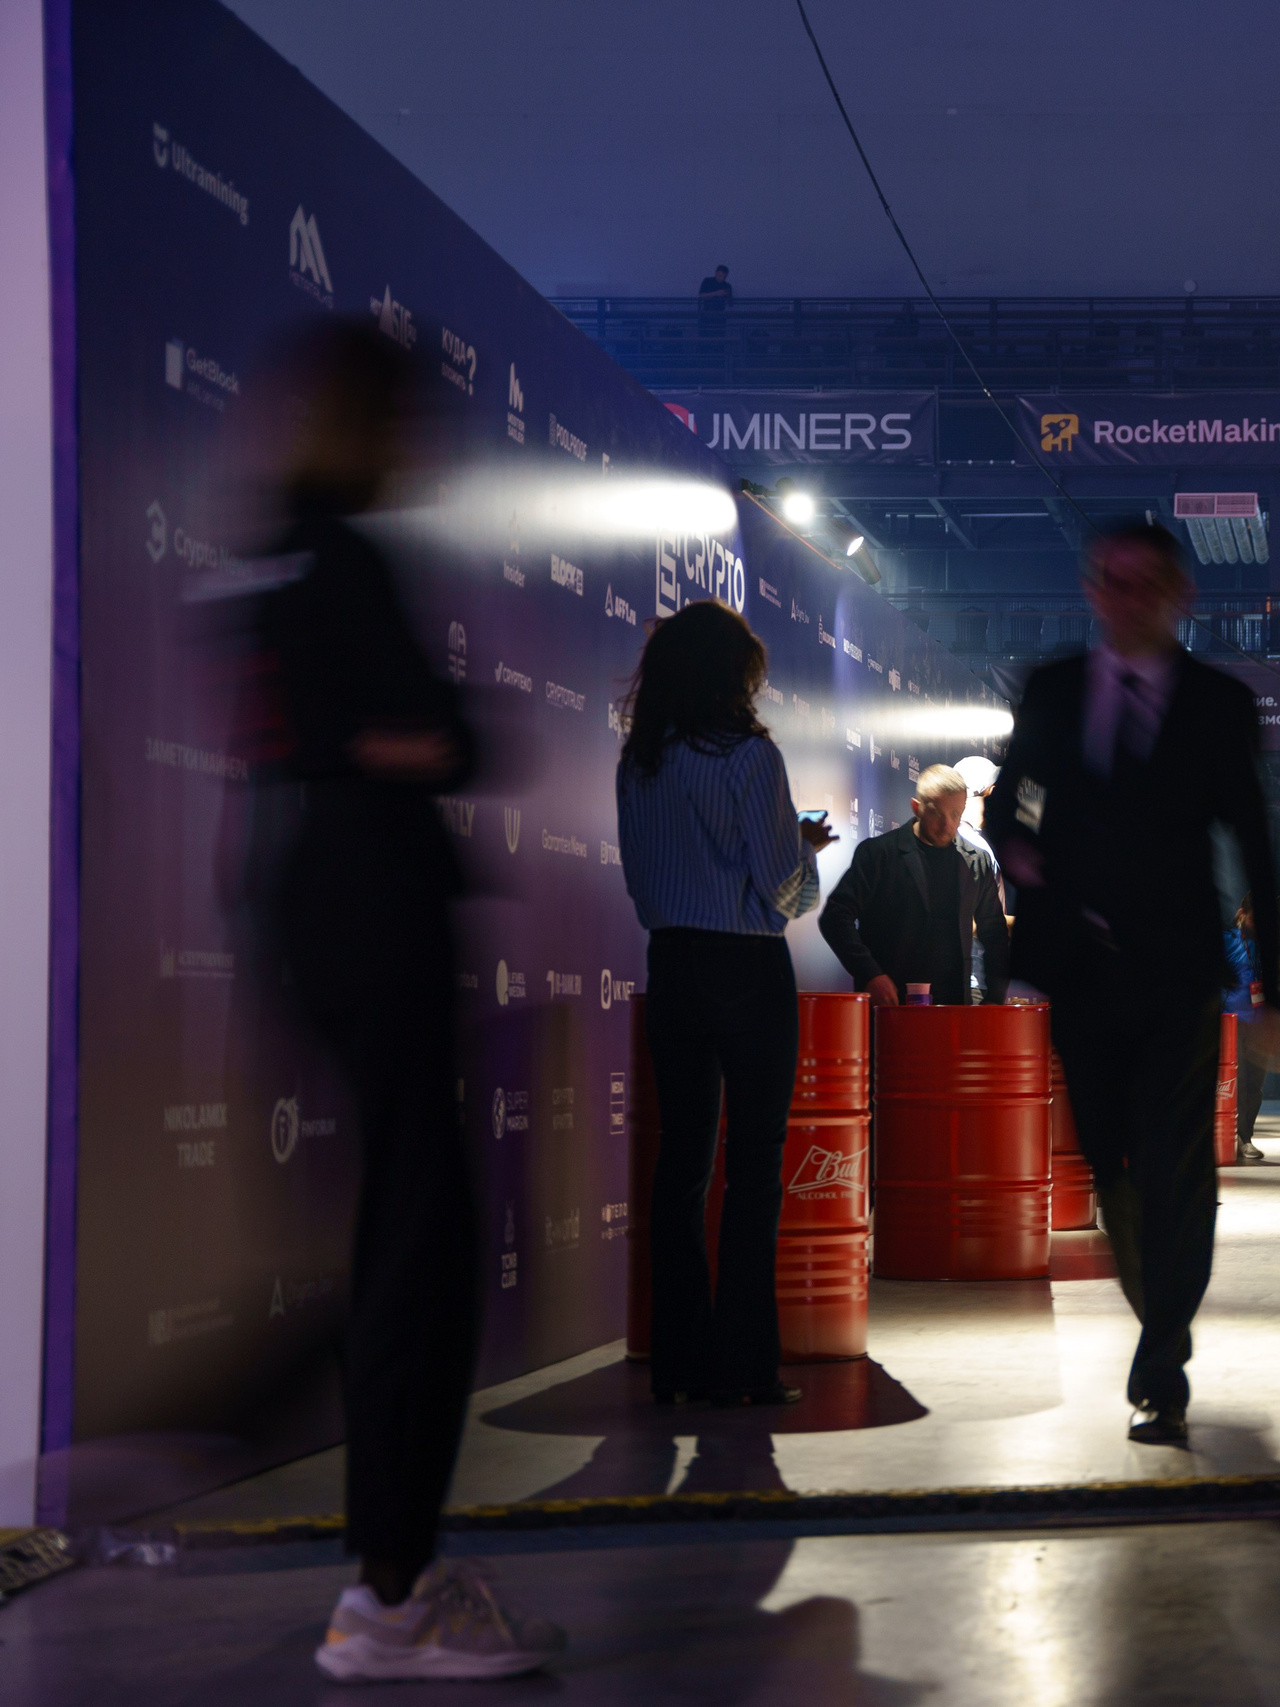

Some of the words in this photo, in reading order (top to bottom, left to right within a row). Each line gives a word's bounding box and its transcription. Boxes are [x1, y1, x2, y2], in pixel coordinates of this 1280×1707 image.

[172, 141, 248, 226] Ultramining
[441, 325, 467, 366] КУДА
[186, 347, 241, 397] GetBlock
[683, 530, 745, 614] CRYPTO
[506, 1091, 528, 1111] SUPER
[176, 1140, 216, 1169] TRADE
[810, 1150, 863, 1181] Bud
[796, 1191, 838, 1200] ALCOHOL
